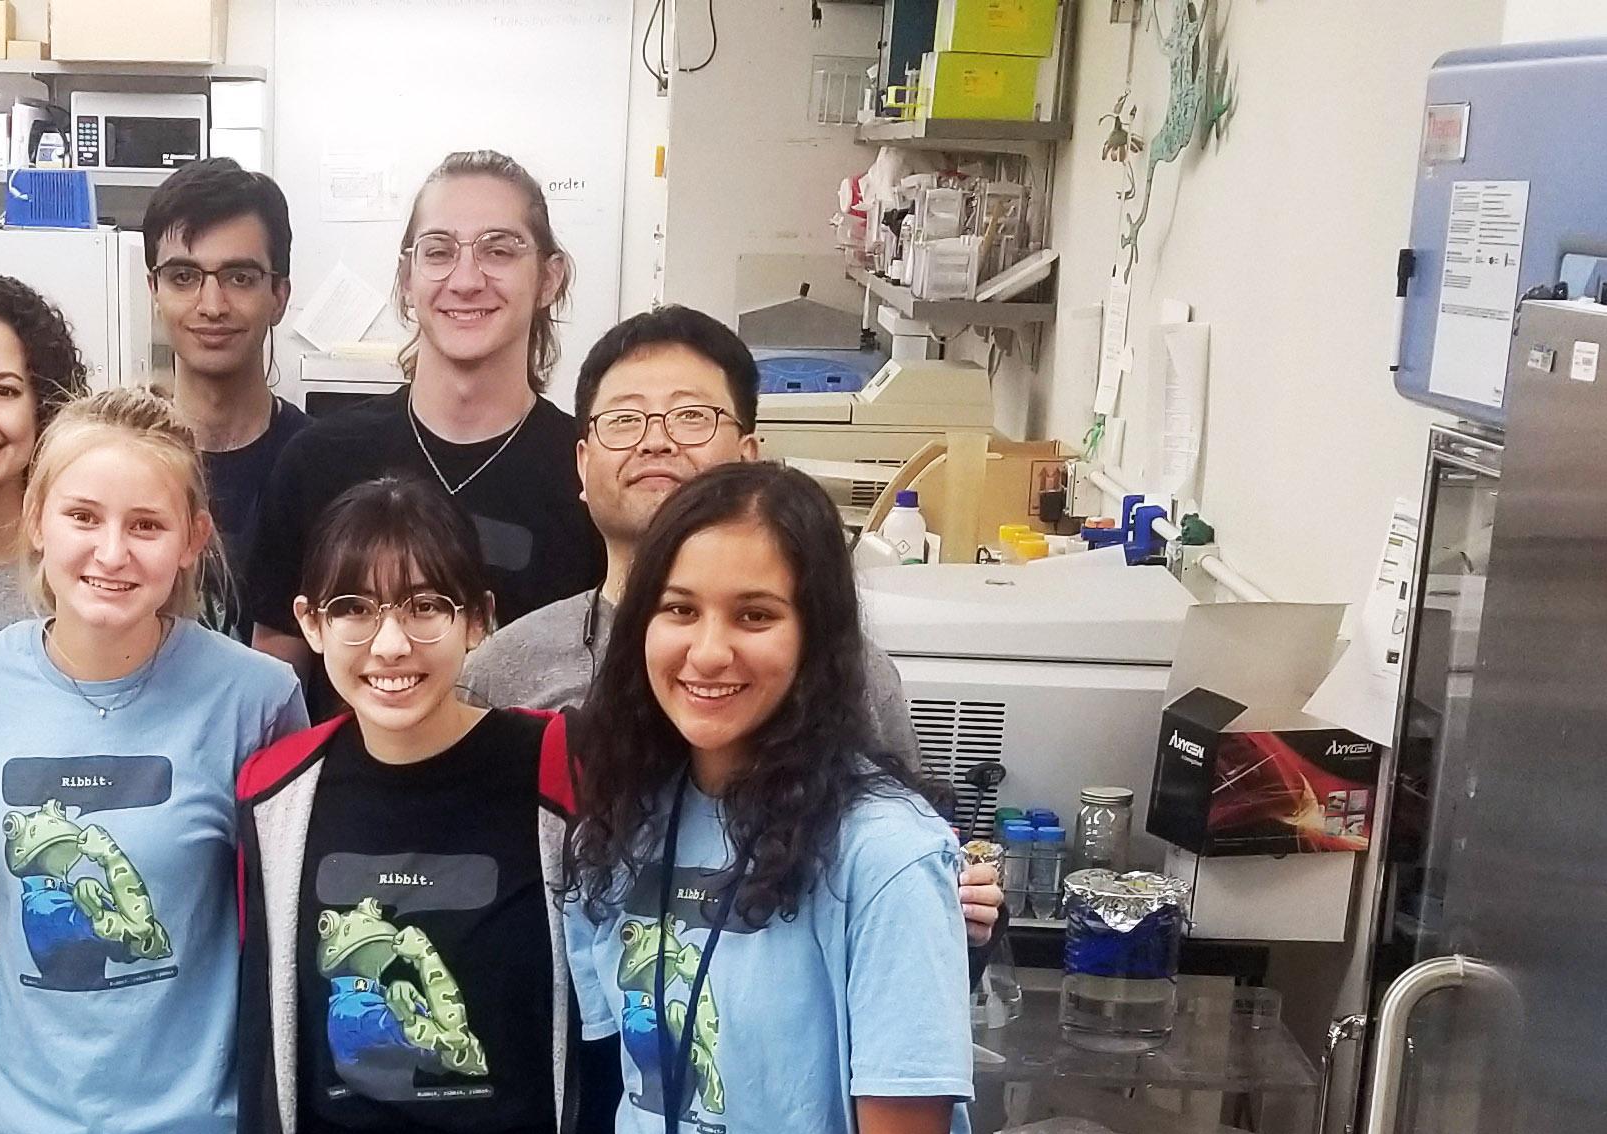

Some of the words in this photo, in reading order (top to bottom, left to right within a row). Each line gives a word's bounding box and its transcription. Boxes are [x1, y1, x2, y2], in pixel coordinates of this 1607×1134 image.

[1168, 730, 1205, 759] AXYGEN
[1325, 740, 1374, 756] AXYGEN
[61, 776, 113, 788] Ribbit.
[378, 872, 435, 887] Ribbit.
[676, 888, 719, 903] Ribbi.
